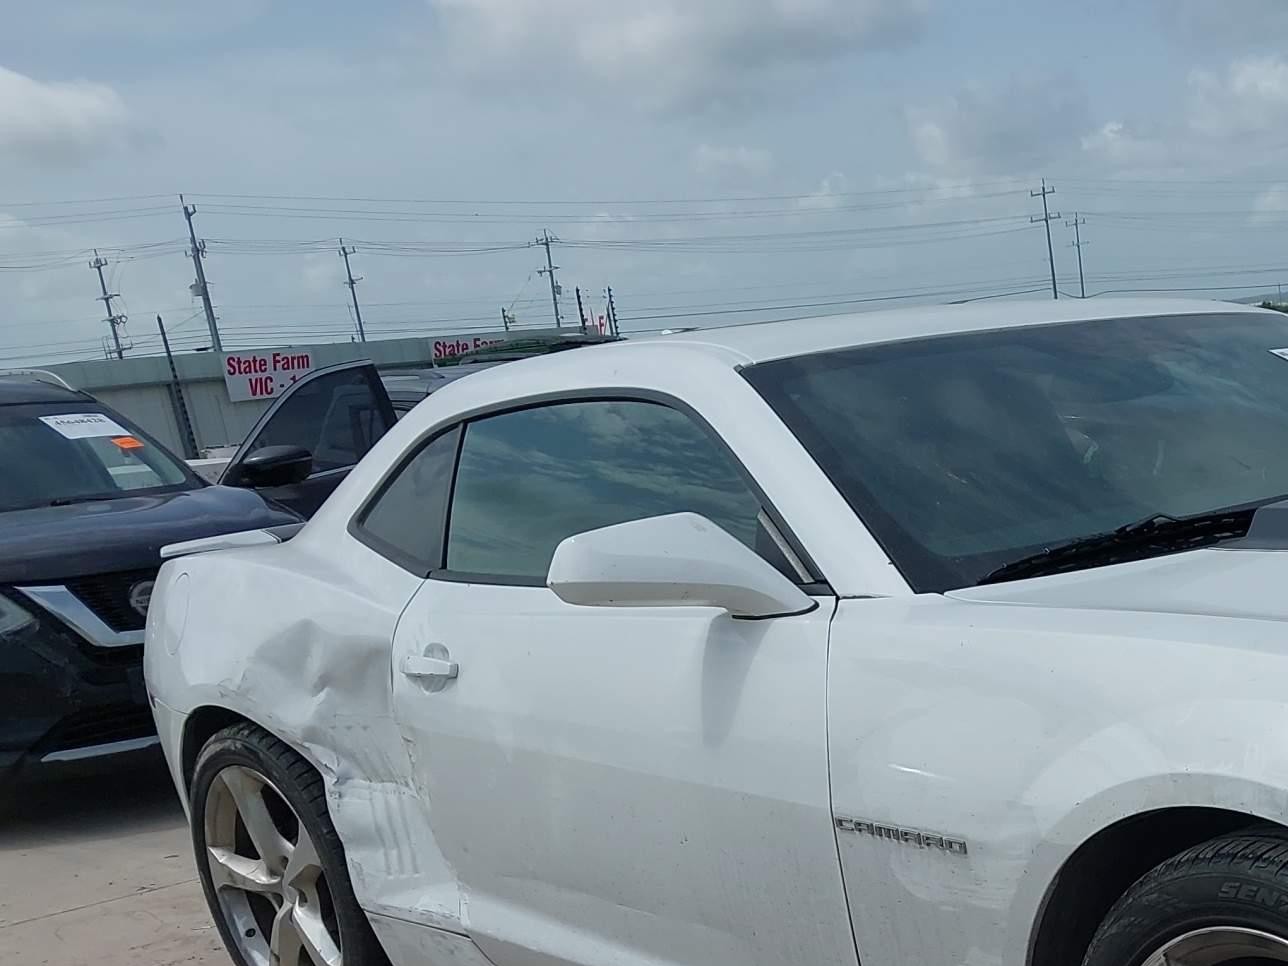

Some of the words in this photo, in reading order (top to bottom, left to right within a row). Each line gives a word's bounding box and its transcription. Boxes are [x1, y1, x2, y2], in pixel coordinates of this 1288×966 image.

[433, 340, 469, 358] State
[226, 355, 268, 376] State
[272, 352, 310, 371] Farm
[248, 376, 274, 396] VIC
[834, 815, 968, 855] CAMARO
